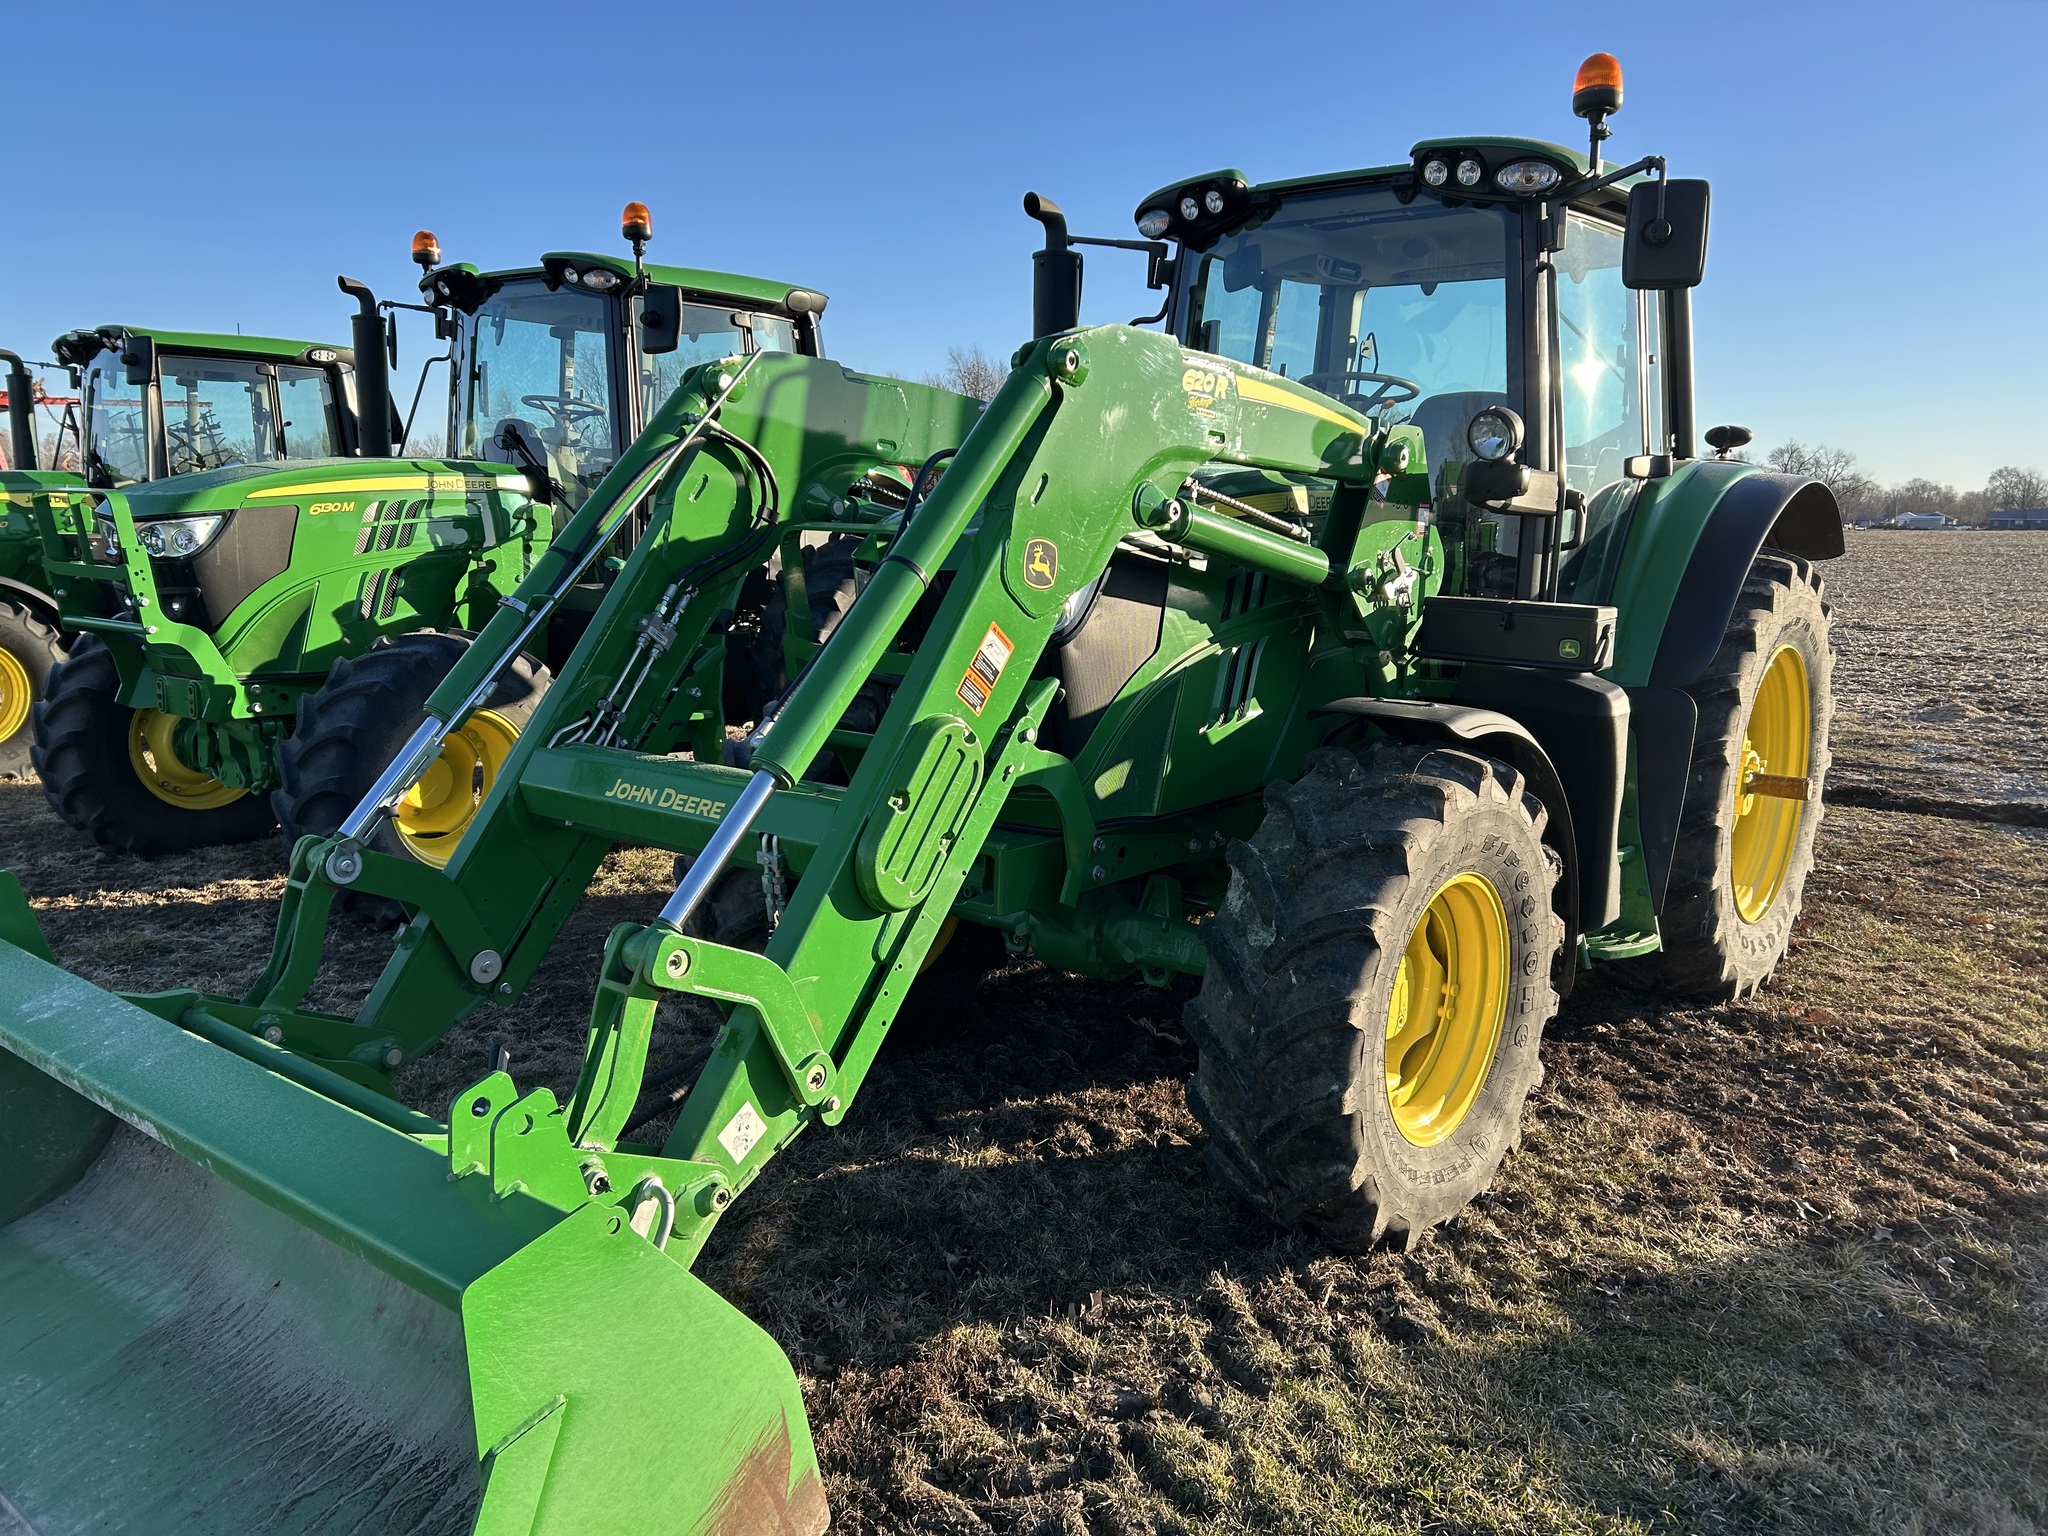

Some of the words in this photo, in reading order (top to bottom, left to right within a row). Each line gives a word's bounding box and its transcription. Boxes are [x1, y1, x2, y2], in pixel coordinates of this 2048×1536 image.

[424, 478, 455, 489] JOHN
[456, 479, 492, 489] DEERE
[1308, 494, 1331, 509] DEER
[605, 779, 658, 805] JOHN
[658, 787, 726, 819] DEERE
